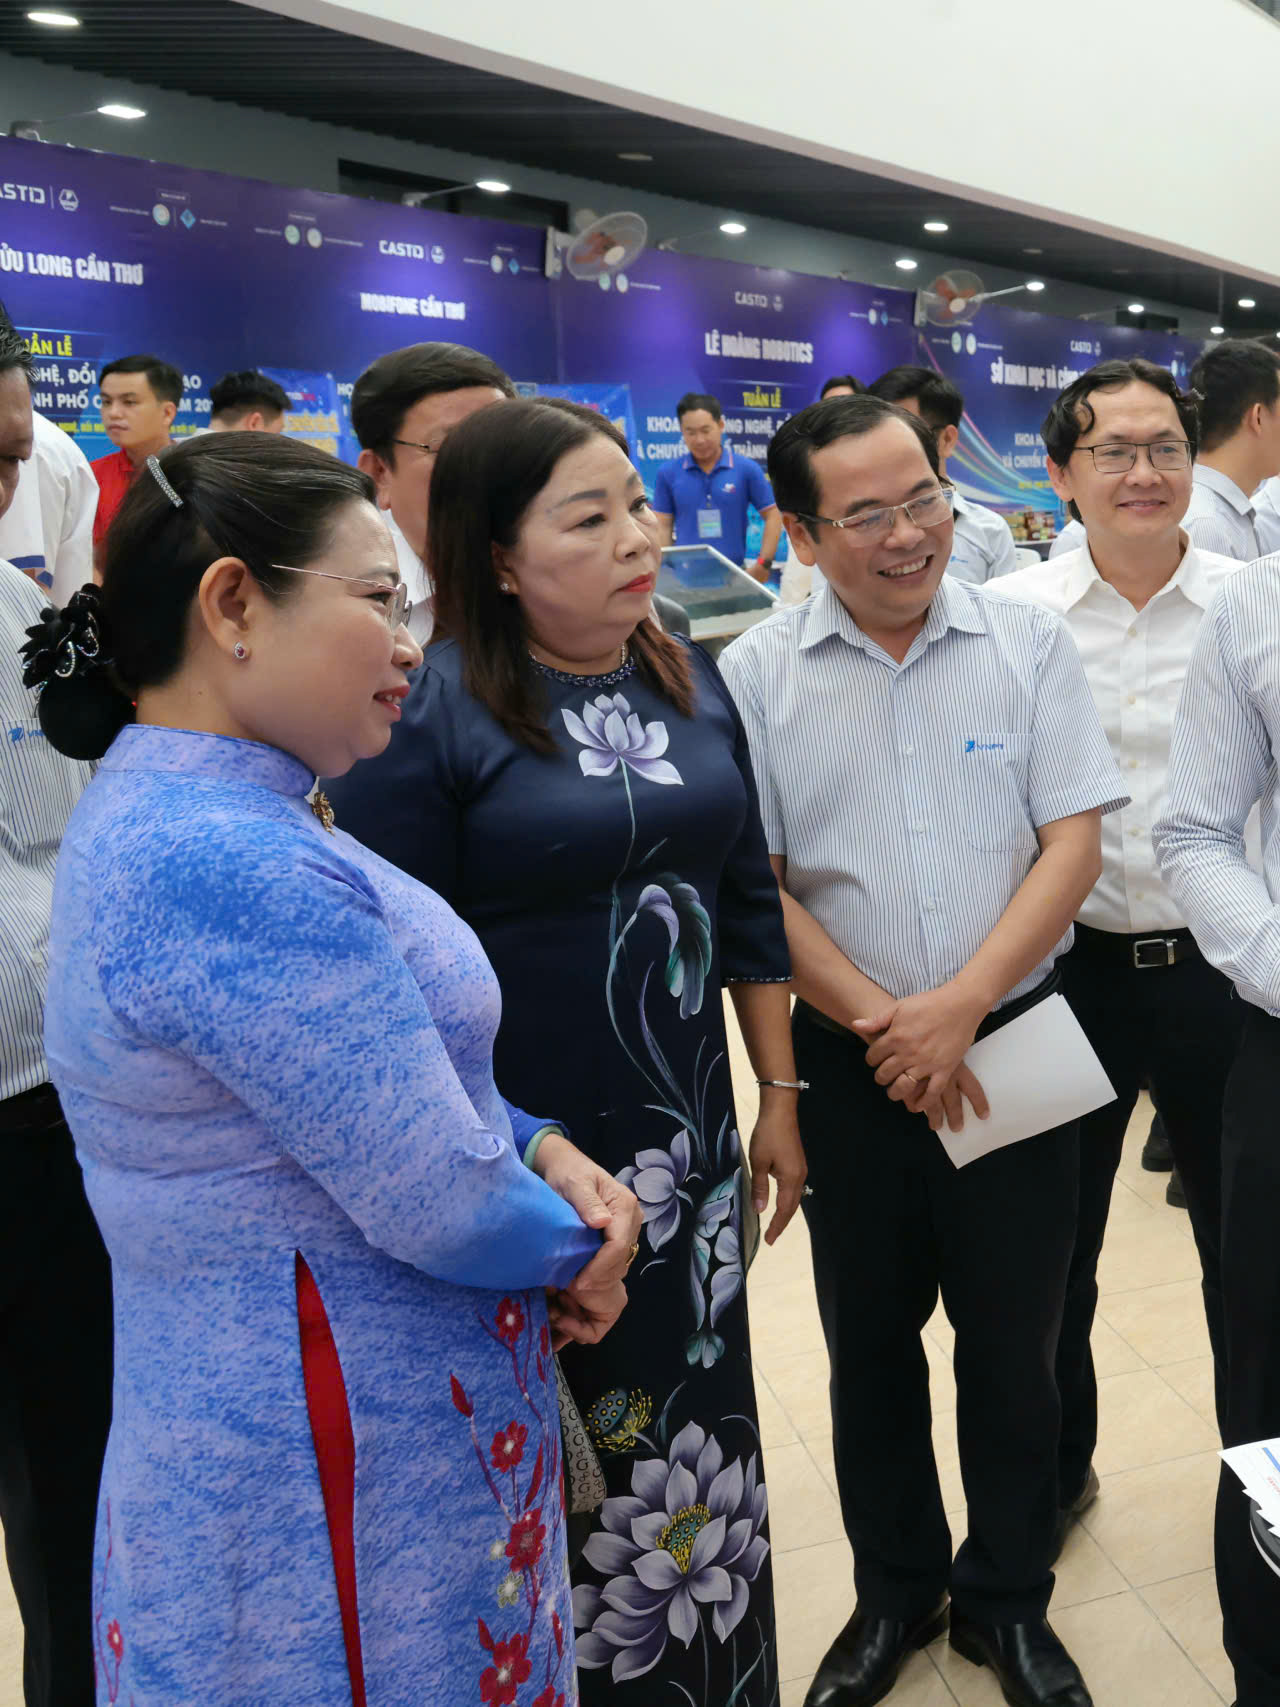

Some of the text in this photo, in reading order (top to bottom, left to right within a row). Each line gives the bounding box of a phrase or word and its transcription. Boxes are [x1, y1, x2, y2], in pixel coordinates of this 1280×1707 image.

[28, 252, 73, 279] LONG
[75, 252, 110, 283] CẦN
[112, 261, 144, 286] THƠ
[360, 292, 419, 317] MOBIFONE
[57, 334, 73, 356] LỄ
[704, 328, 814, 364] LÊ HOÀNG ROBOTICS
[68, 362, 97, 384] ĐỔI
[990, 356, 1004, 385] SỞ
[1004, 363, 1027, 387] KHOA
[56, 389, 89, 409] PHỐ
[743, 385, 782, 408] TUẦN LỄ
